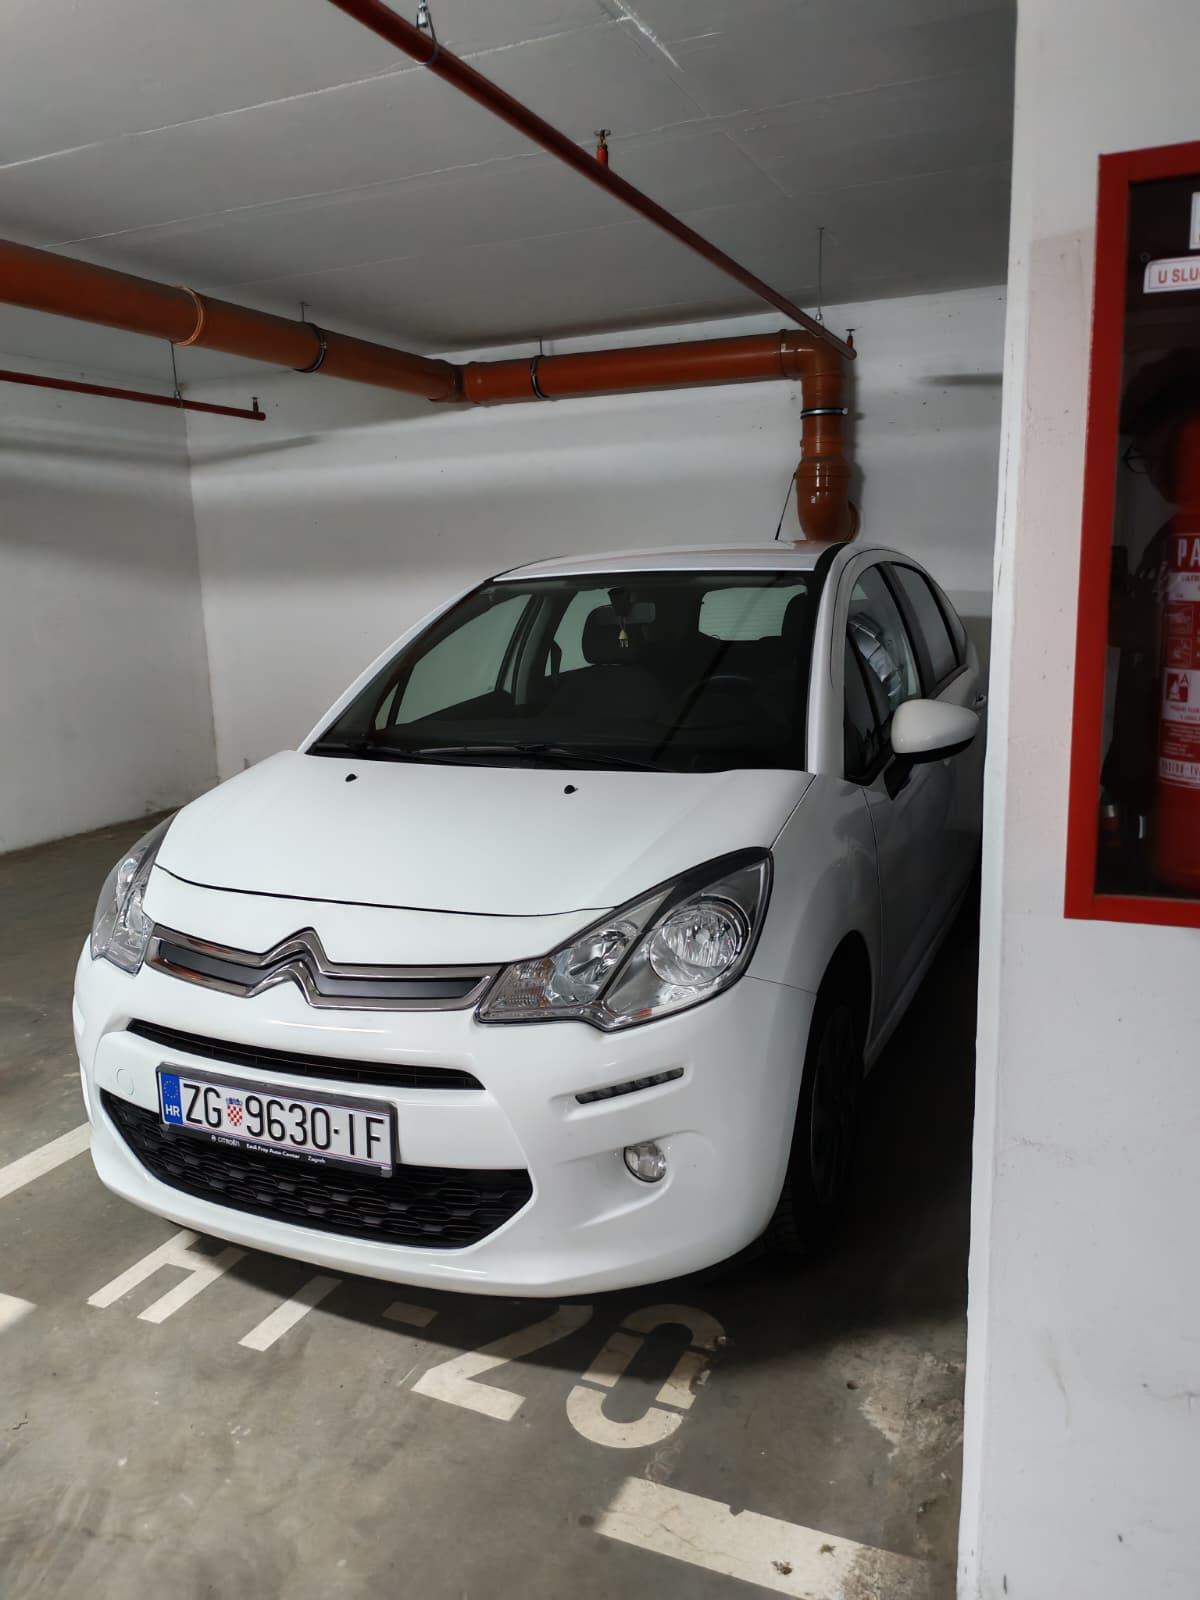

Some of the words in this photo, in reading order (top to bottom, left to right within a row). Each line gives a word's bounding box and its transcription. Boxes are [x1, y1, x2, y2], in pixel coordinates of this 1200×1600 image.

[1158, 270, 1168, 284] U
[1172, 267, 1200, 283] SLU
[164, 1104, 181, 1118] HR
[183, 1083, 222, 1128] ZG
